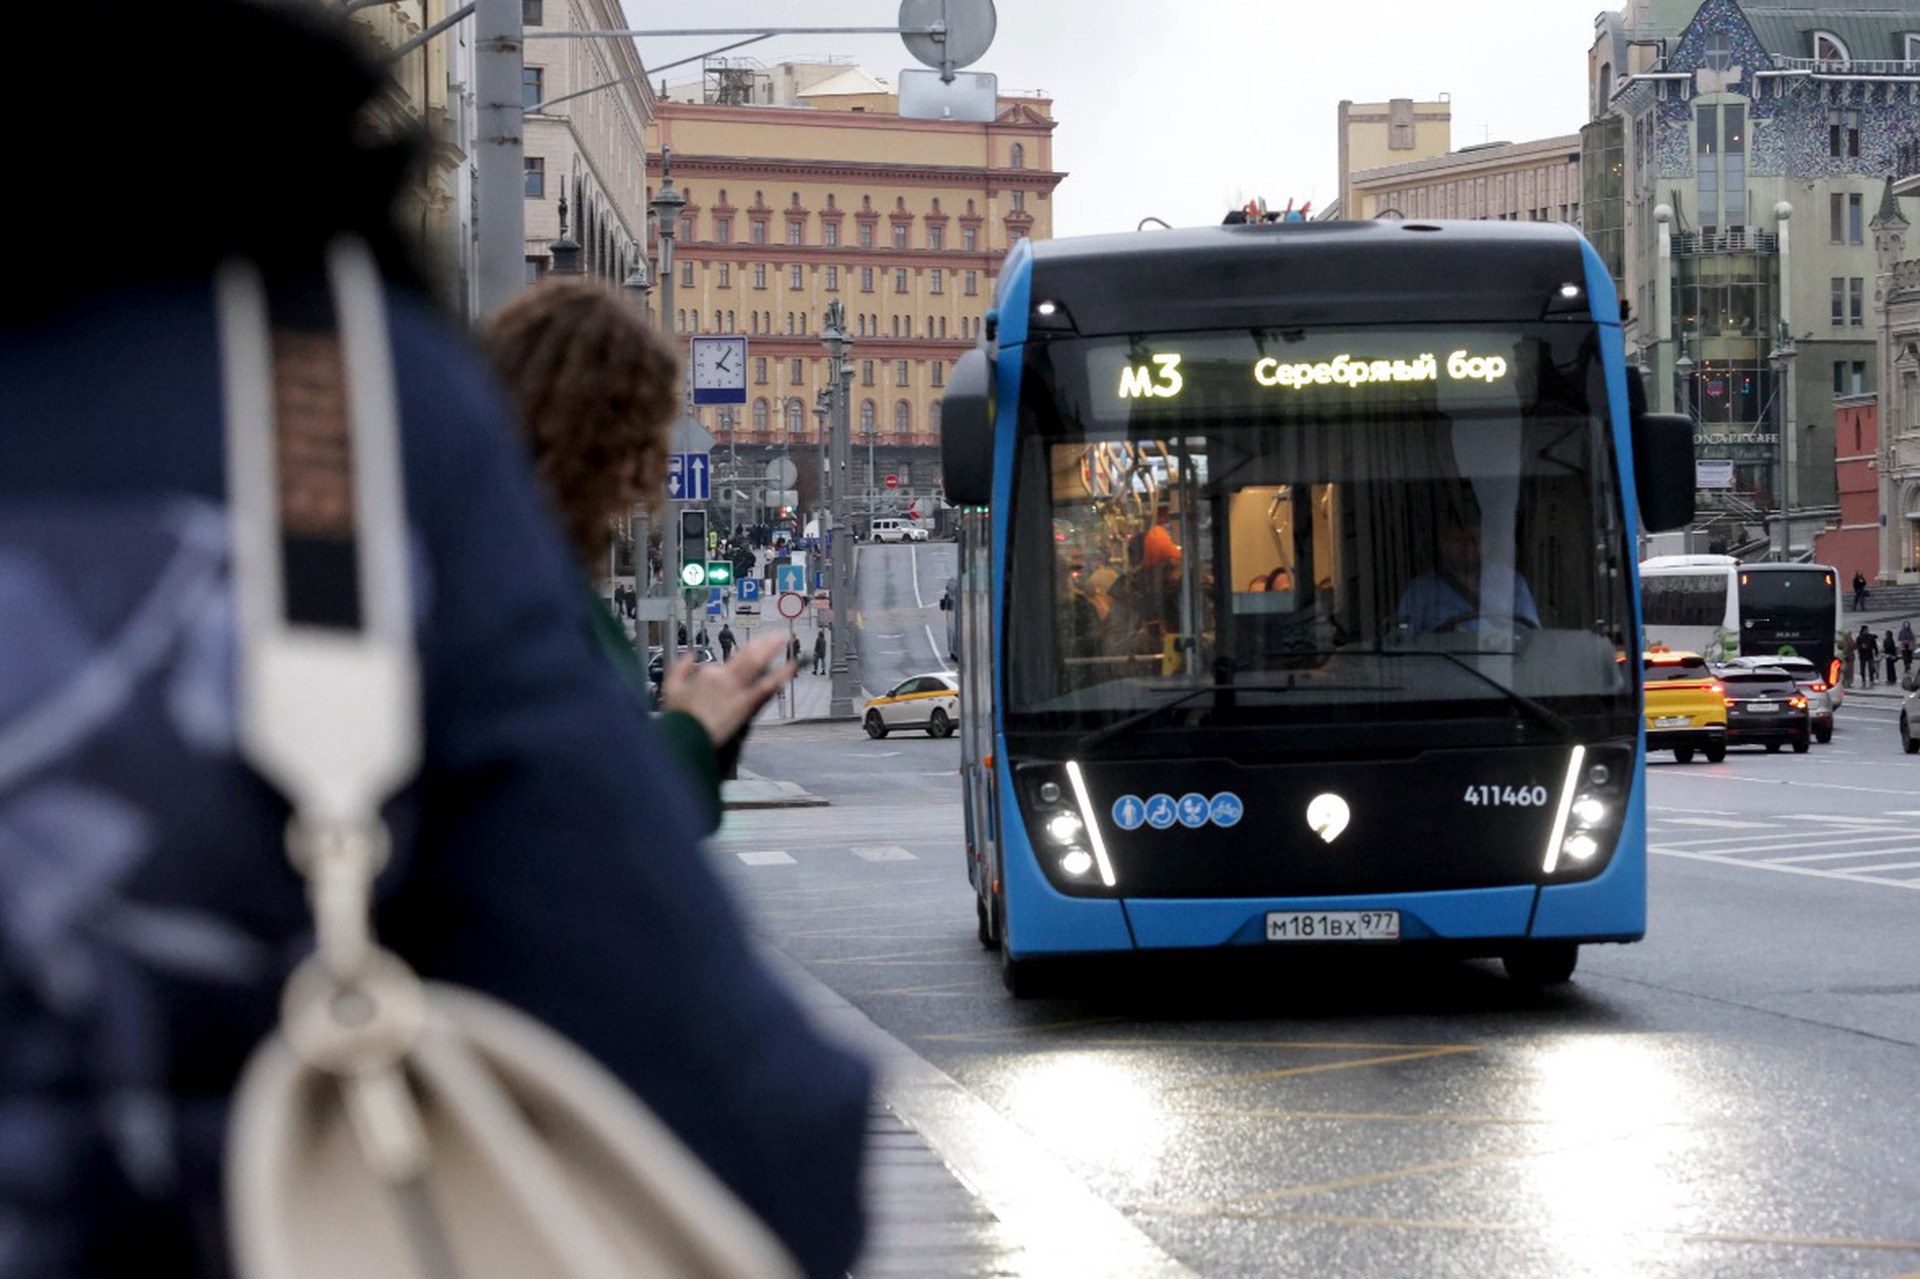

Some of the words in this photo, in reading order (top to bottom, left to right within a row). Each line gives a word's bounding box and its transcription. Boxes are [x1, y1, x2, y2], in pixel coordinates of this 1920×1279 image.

[1253, 352, 1438, 390] Серебряный
[1446, 349, 1507, 383] бор
[1463, 785, 1548, 806] 411460
[1361, 912, 1393, 930] 977
